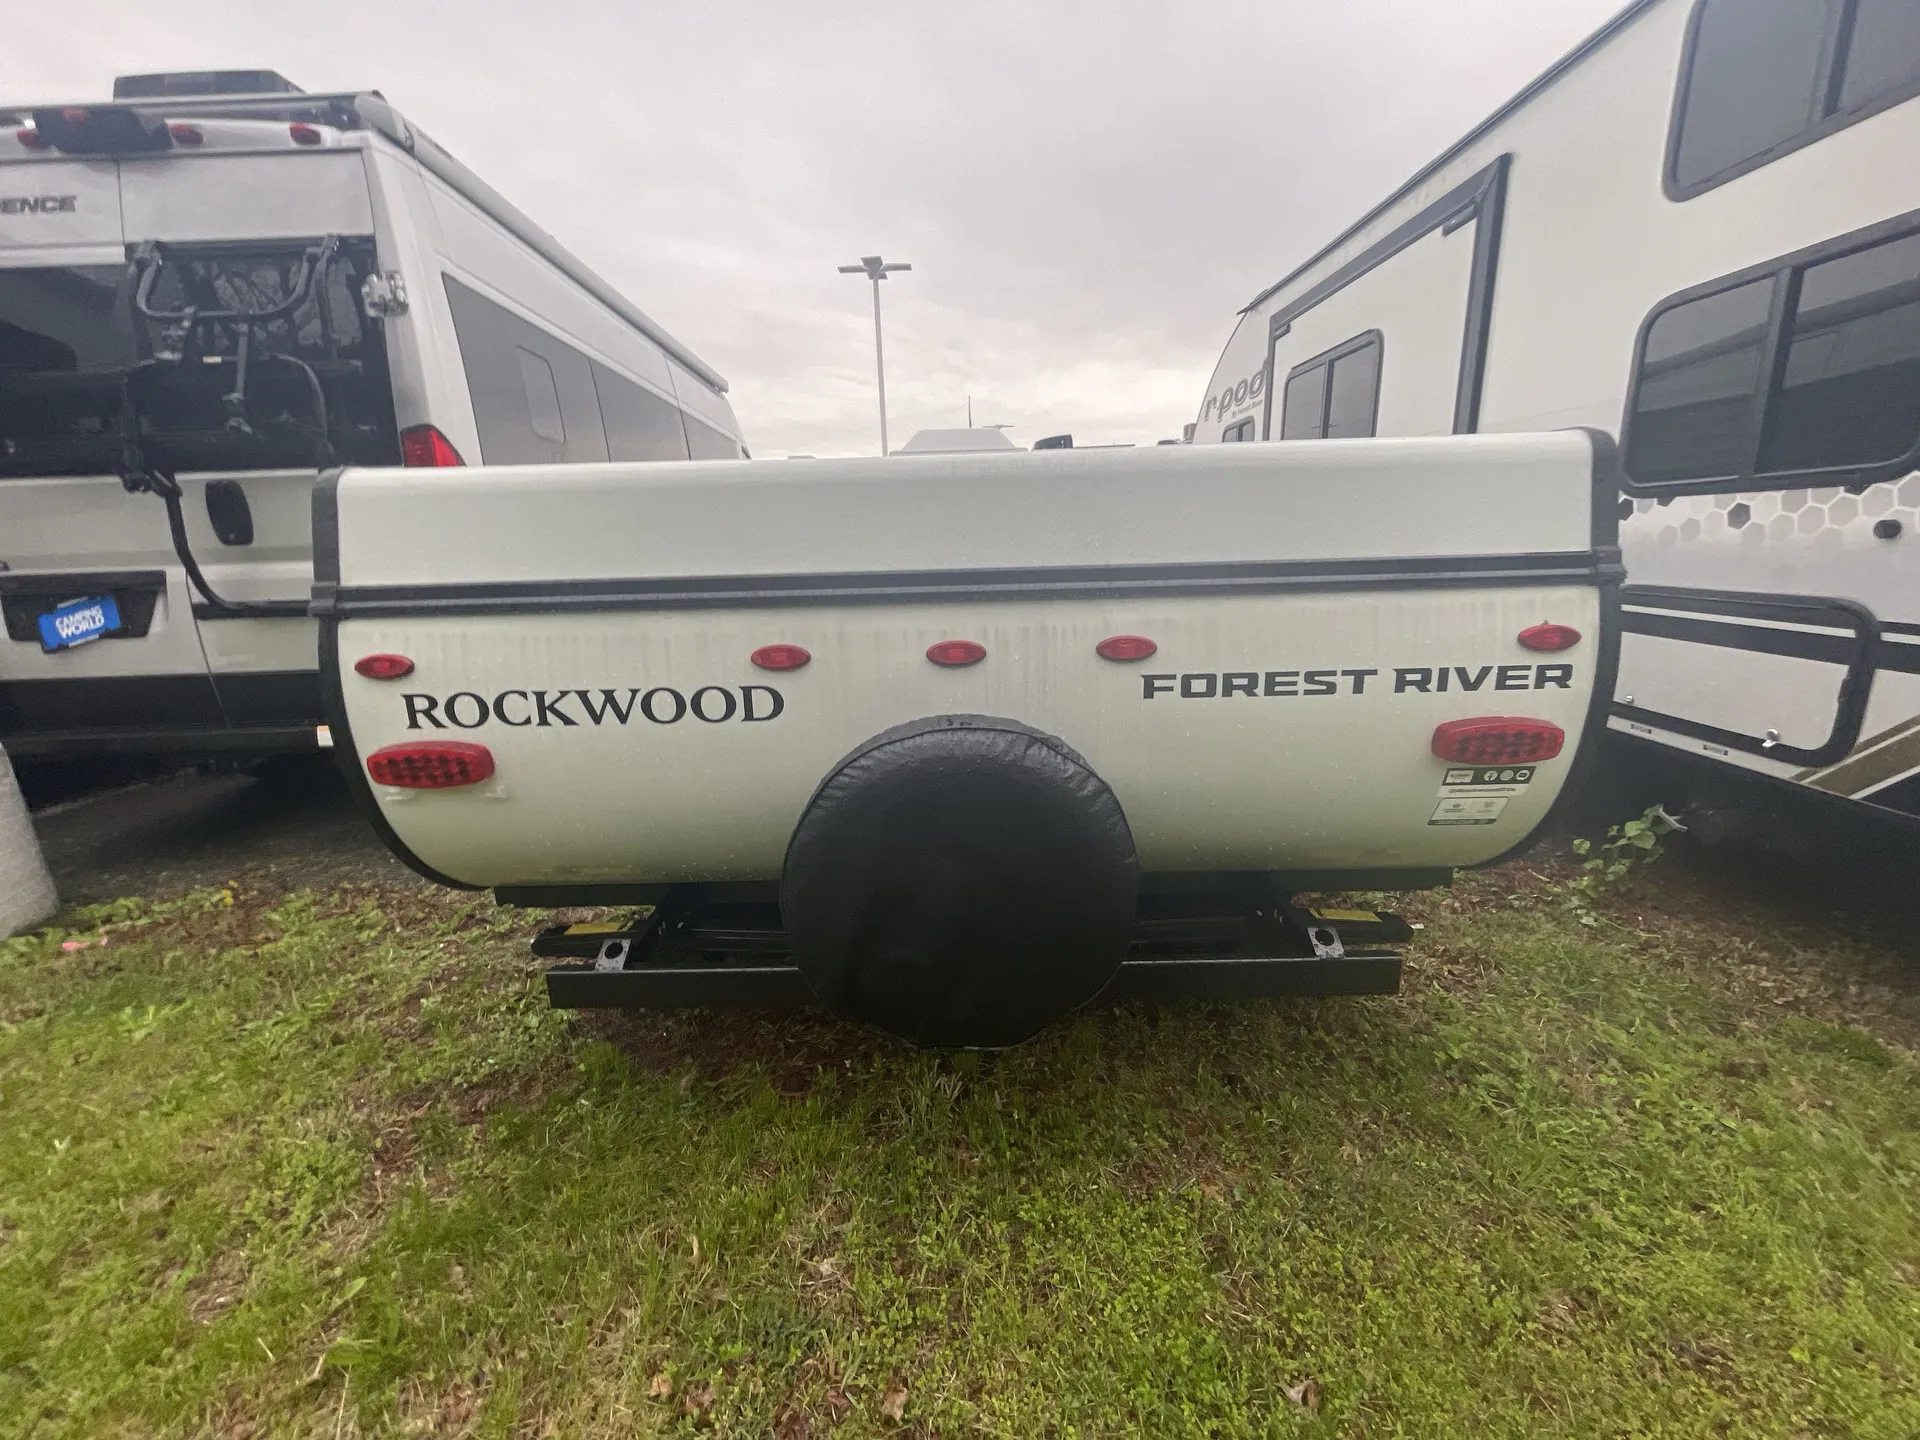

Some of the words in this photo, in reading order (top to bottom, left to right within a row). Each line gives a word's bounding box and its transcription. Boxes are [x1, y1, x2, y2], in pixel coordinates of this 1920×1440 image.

[58, 613, 105, 639] WORLD
[1141, 669, 1378, 699] FOREST
[1393, 664, 1573, 693] RIVER
[400, 685, 785, 729] ROCKWOOD
